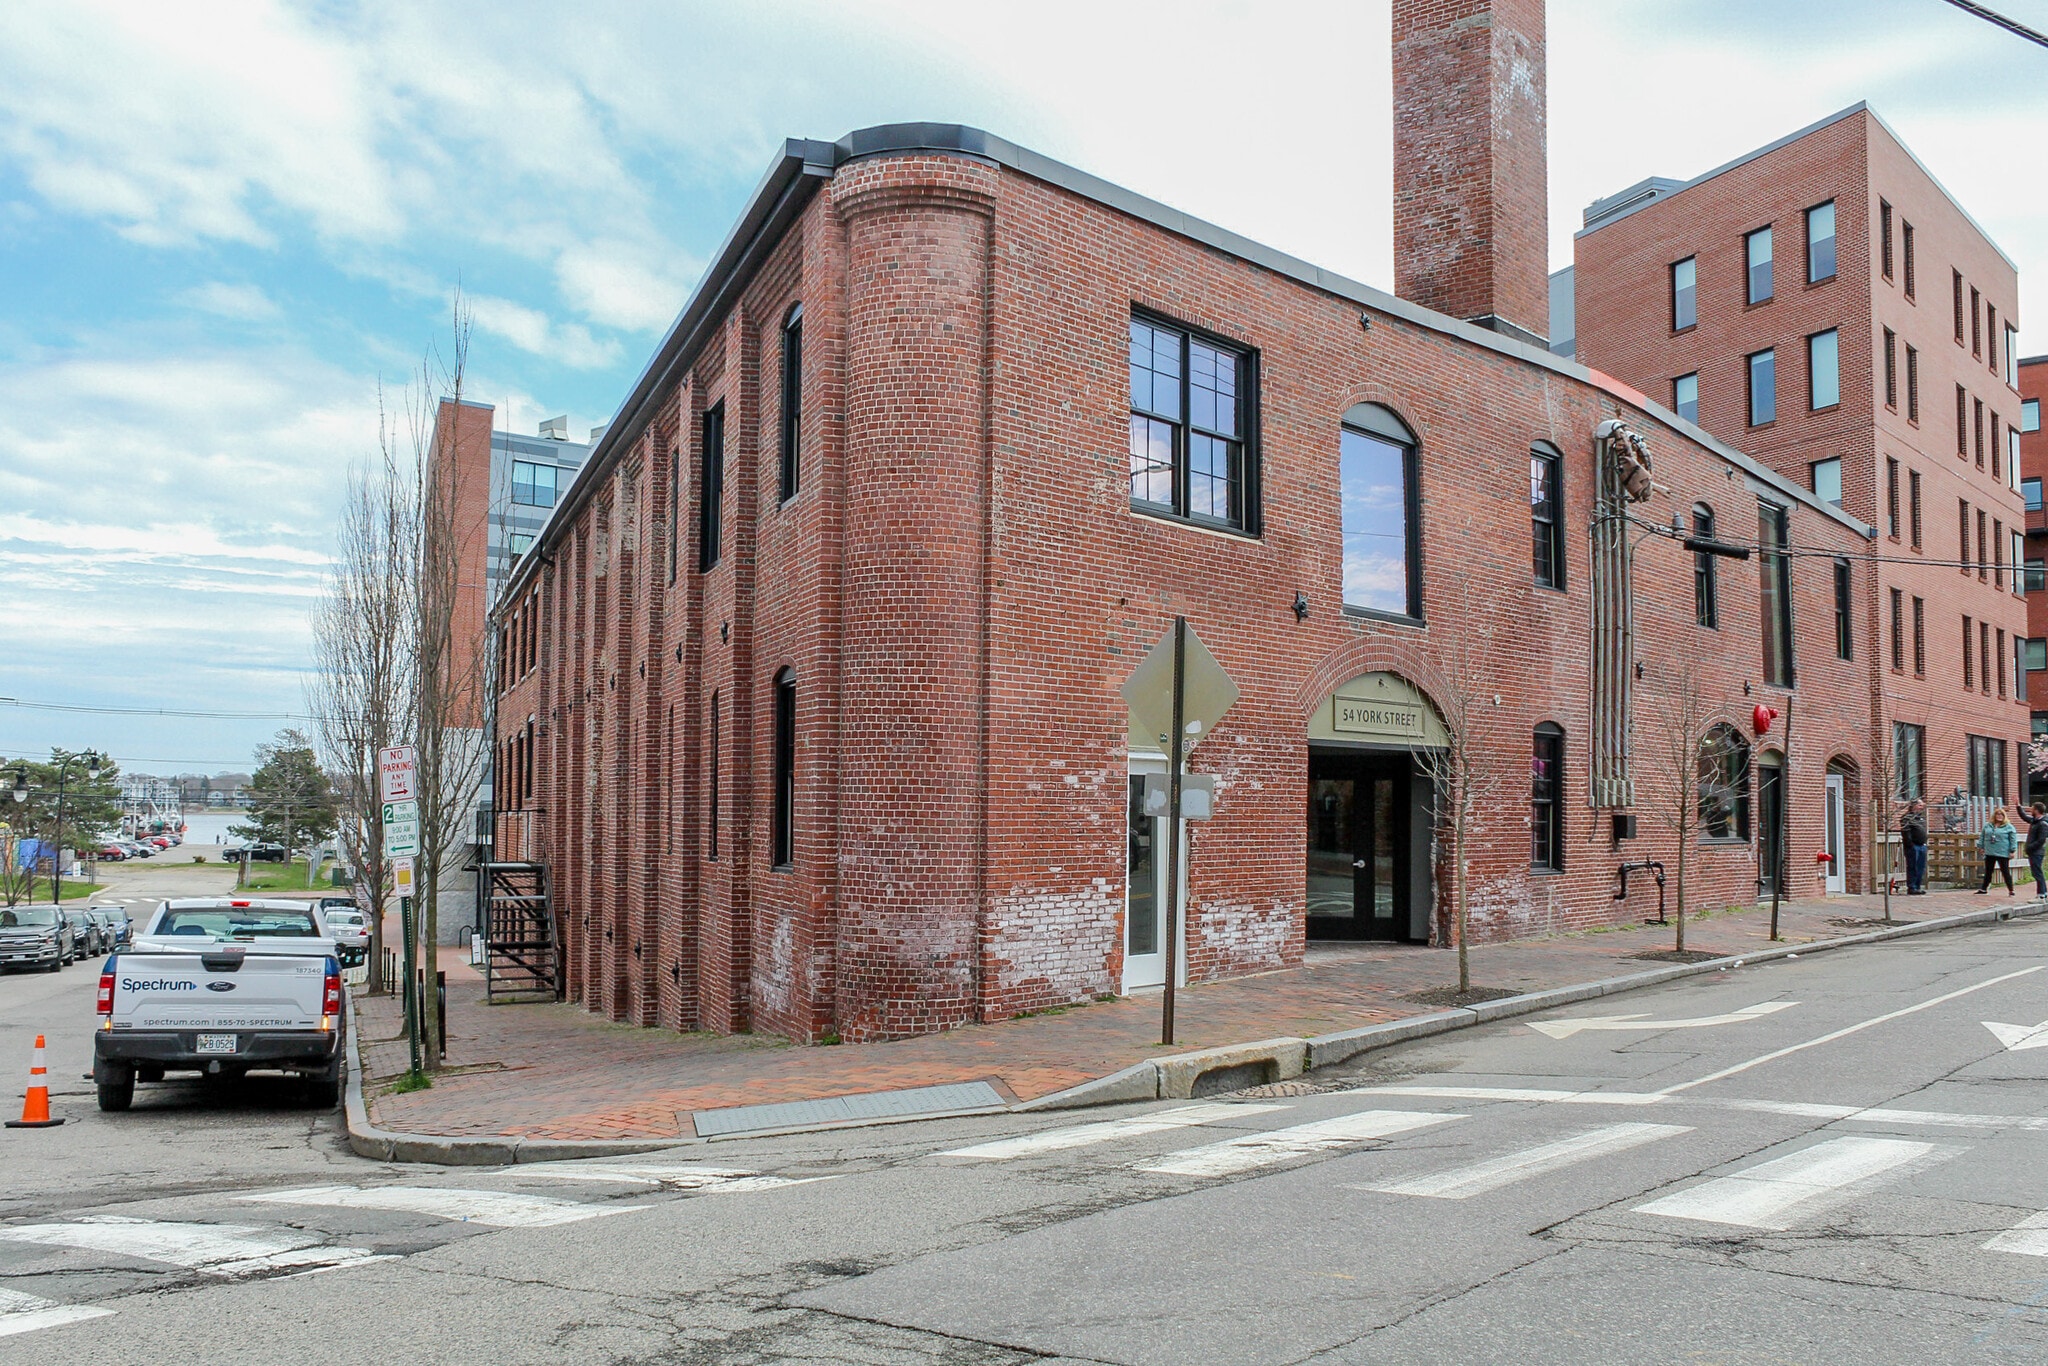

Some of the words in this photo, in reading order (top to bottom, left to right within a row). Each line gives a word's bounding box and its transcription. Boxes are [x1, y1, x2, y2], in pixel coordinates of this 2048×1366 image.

[1343, 709, 1354, 721] 54
[1356, 709, 1382, 724] YORK
[1384, 712, 1416, 726] STREET
[390, 750, 403, 760] NO
[383, 761, 412, 773] PARKING
[391, 781, 407, 789] TIME
[385, 807, 393, 821] 2
[394, 812, 415, 820] PARKING
[122, 978, 192, 993] Spectrum
